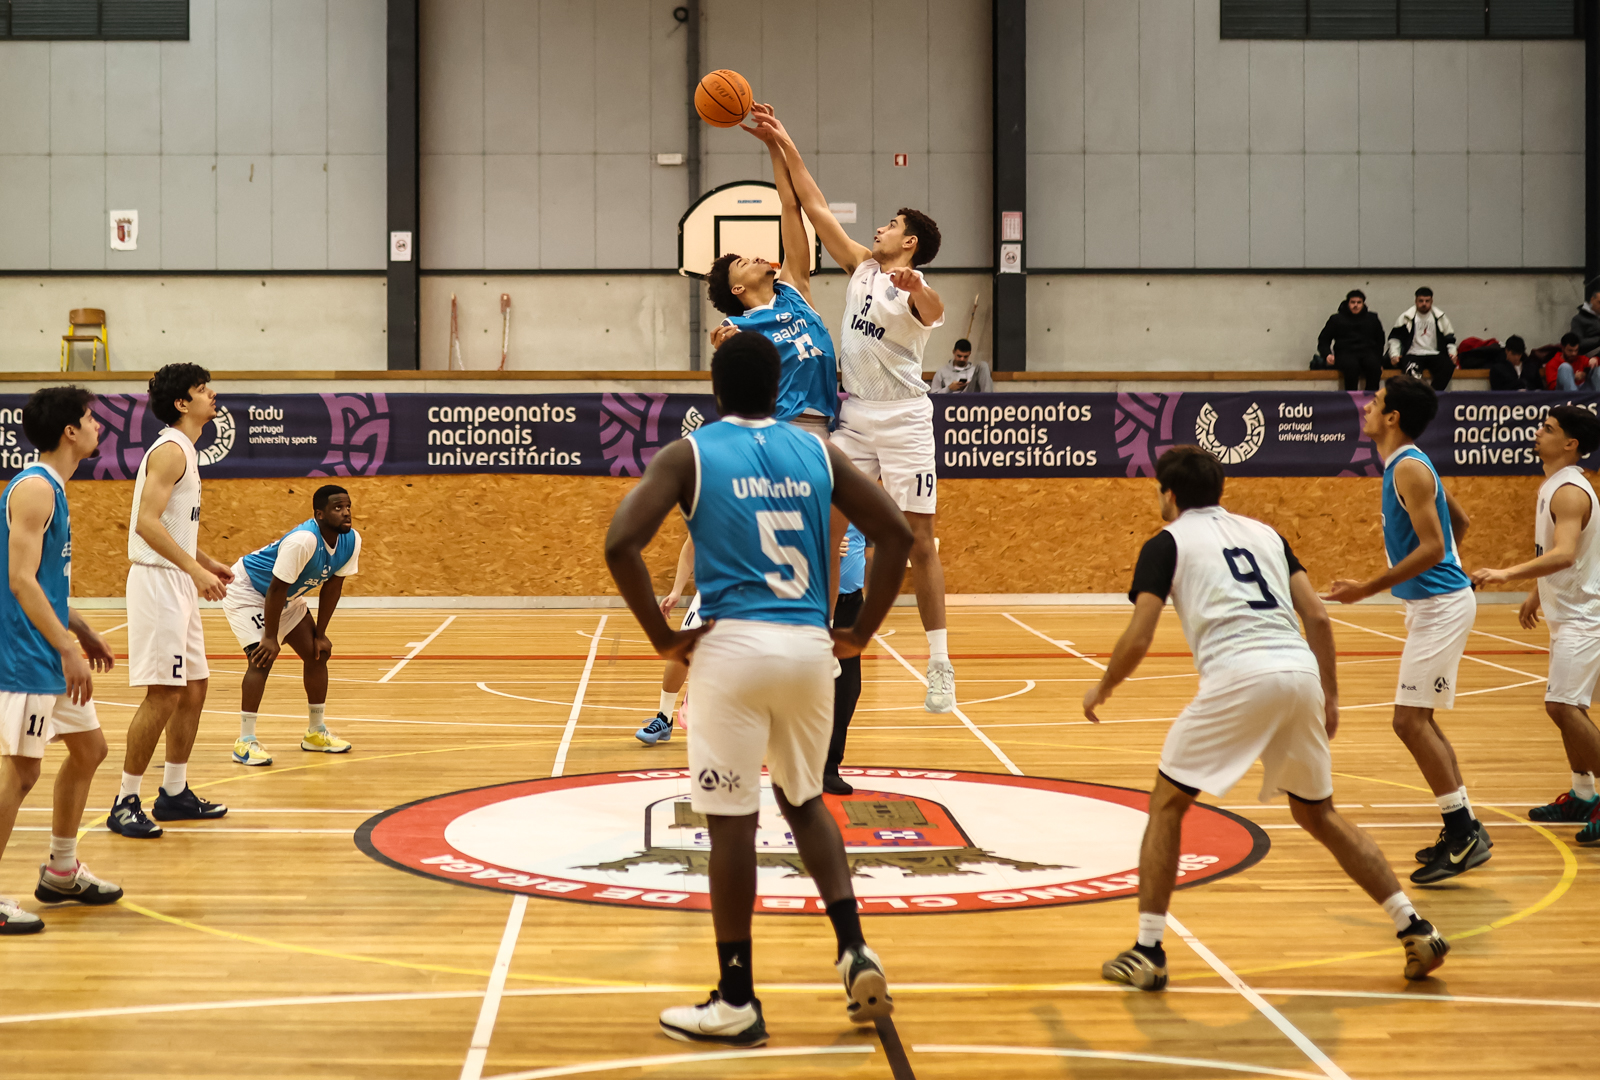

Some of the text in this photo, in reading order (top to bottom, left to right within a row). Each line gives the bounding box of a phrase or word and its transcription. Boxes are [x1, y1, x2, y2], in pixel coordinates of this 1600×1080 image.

[772, 318, 808, 343] aaum
[248, 405, 284, 421] fadu
[428, 402, 577, 427] campeonatos
[944, 401, 1092, 427] campeonatos
[1278, 402, 1313, 419] fadu
[1453, 400, 1598, 425] campeons
[249, 424, 284, 435] portugal
[428, 424, 532, 445] nacionais
[944, 423, 1048, 445] nacionais
[1278, 421, 1313, 433] portugal
[1278, 432, 1346, 443] university sports
[1453, 421, 1543, 443] naciona
[249, 435, 318, 446] university sports
[428, 446, 582, 466] universitários
[944, 444, 1097, 467] universitários
[732, 476, 811, 500] UMinho
[915, 473, 934, 497] 19
[756, 511, 809, 599] 5
[1223, 547, 1279, 610] 9
[251, 613, 265, 630] 15
[172, 655, 183, 679] 2
[26, 714, 45, 738] 11
[420, 854, 587, 893] BRAGA
[593, 887, 690, 904] DE
